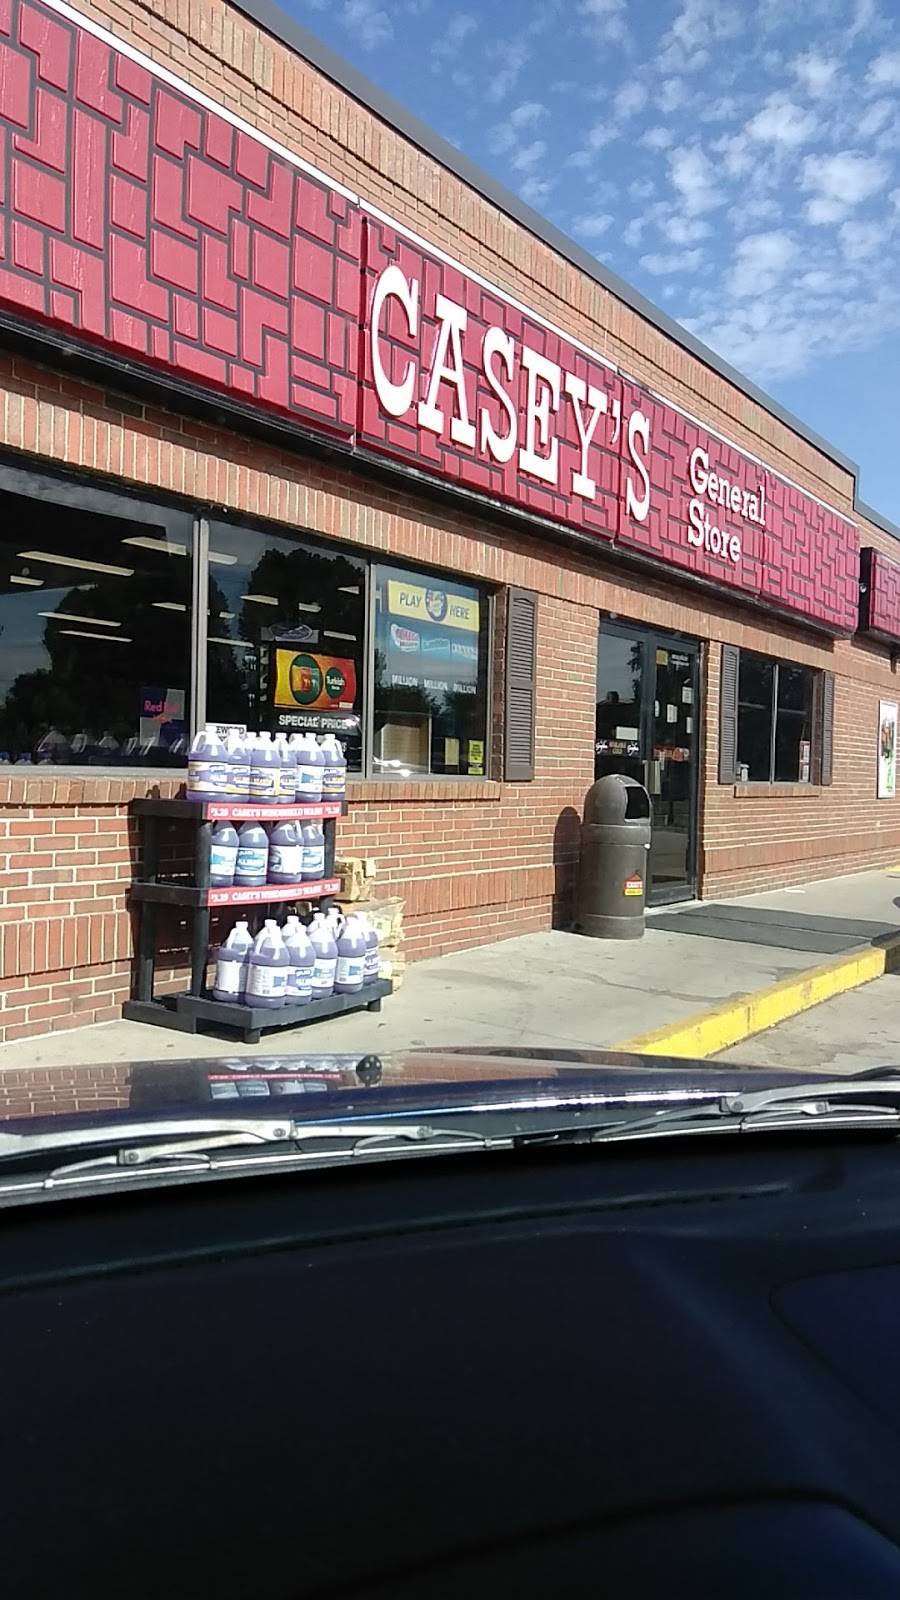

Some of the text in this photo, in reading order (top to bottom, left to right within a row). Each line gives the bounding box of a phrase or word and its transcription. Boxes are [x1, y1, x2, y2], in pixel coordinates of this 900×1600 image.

[371, 264, 650, 522] CASEY'S
[689, 447, 766, 526] General
[687, 497, 741, 563] Store
[399, 592, 422, 608] PLAY
[450, 604, 470, 620] HERE
[391, 674, 419, 687] MILLION
[423, 678, 449, 691] MILLION
[144, 699, 163, 713] Red
[278, 714, 320, 728] SPECIAL
[232, 807, 261, 817] CASEY'S
[232, 889, 261, 902] CASEY'S
